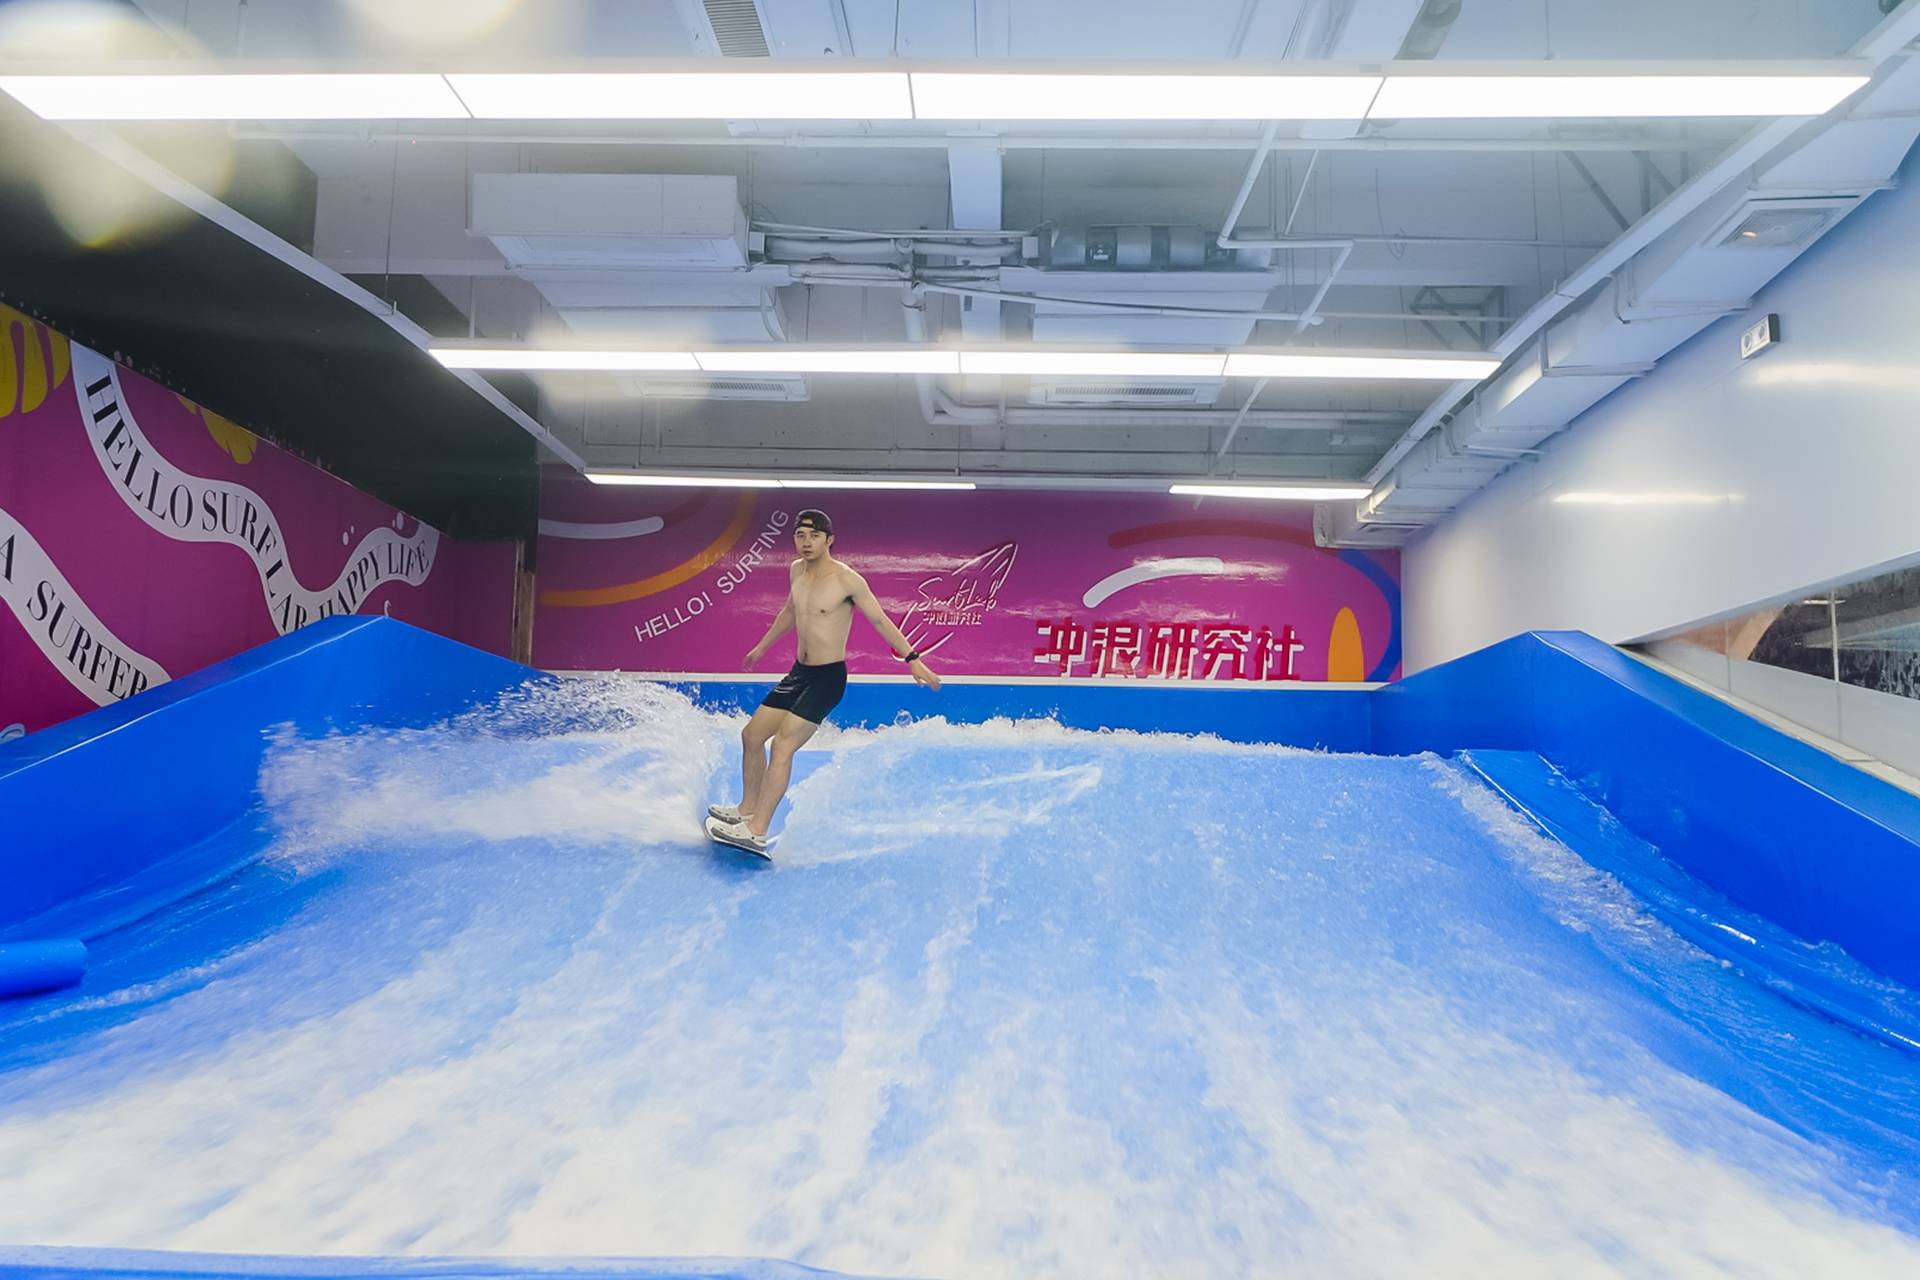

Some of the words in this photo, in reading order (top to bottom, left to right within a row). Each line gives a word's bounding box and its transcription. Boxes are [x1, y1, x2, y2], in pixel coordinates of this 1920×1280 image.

[84, 369, 193, 529] HELLO
[202, 489, 277, 556] SURF
[387, 540, 430, 578] LIFE
[634, 591, 714, 642] HELLO!
[716, 509, 789, 594] SURFING
[26, 580, 149, 701] SURFER
[1032, 617, 1304, 681] 冲浪研究社
